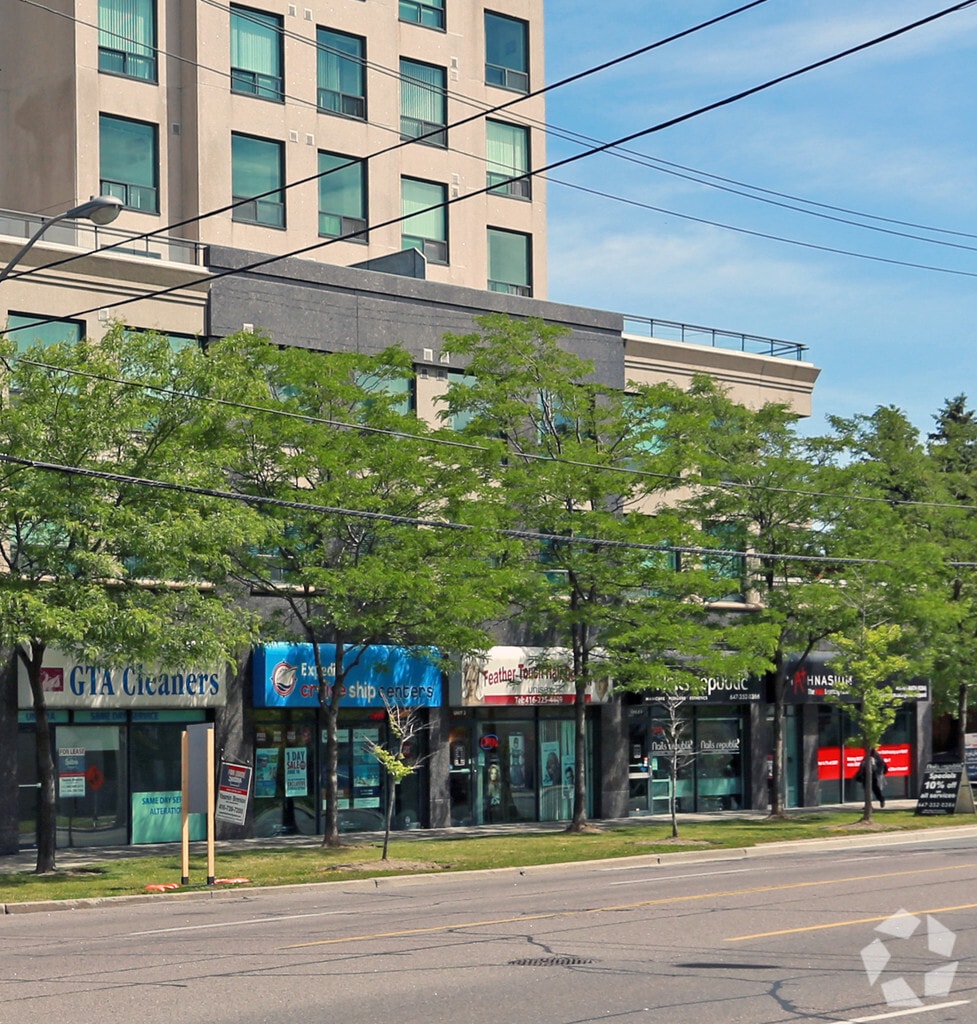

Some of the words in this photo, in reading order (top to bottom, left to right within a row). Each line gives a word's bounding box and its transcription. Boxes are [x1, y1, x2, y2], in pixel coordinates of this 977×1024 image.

[70, 665, 115, 696] GTA
[123, 665, 219, 696] Cleaners
[484, 666, 516, 687] Feather
[349, 681, 376, 703] ship
[379, 684, 433, 698] centers
[651, 741, 668, 751] Nails
[700, 741, 715, 750] Nails
[716, 739, 740, 750] republic
[292, 751, 305, 761] DAY
[929, 772, 957, 780] Specials
[924, 781, 945, 789] 10%
[142, 797, 158, 805] SAME
[160, 796, 172, 804] DAY
